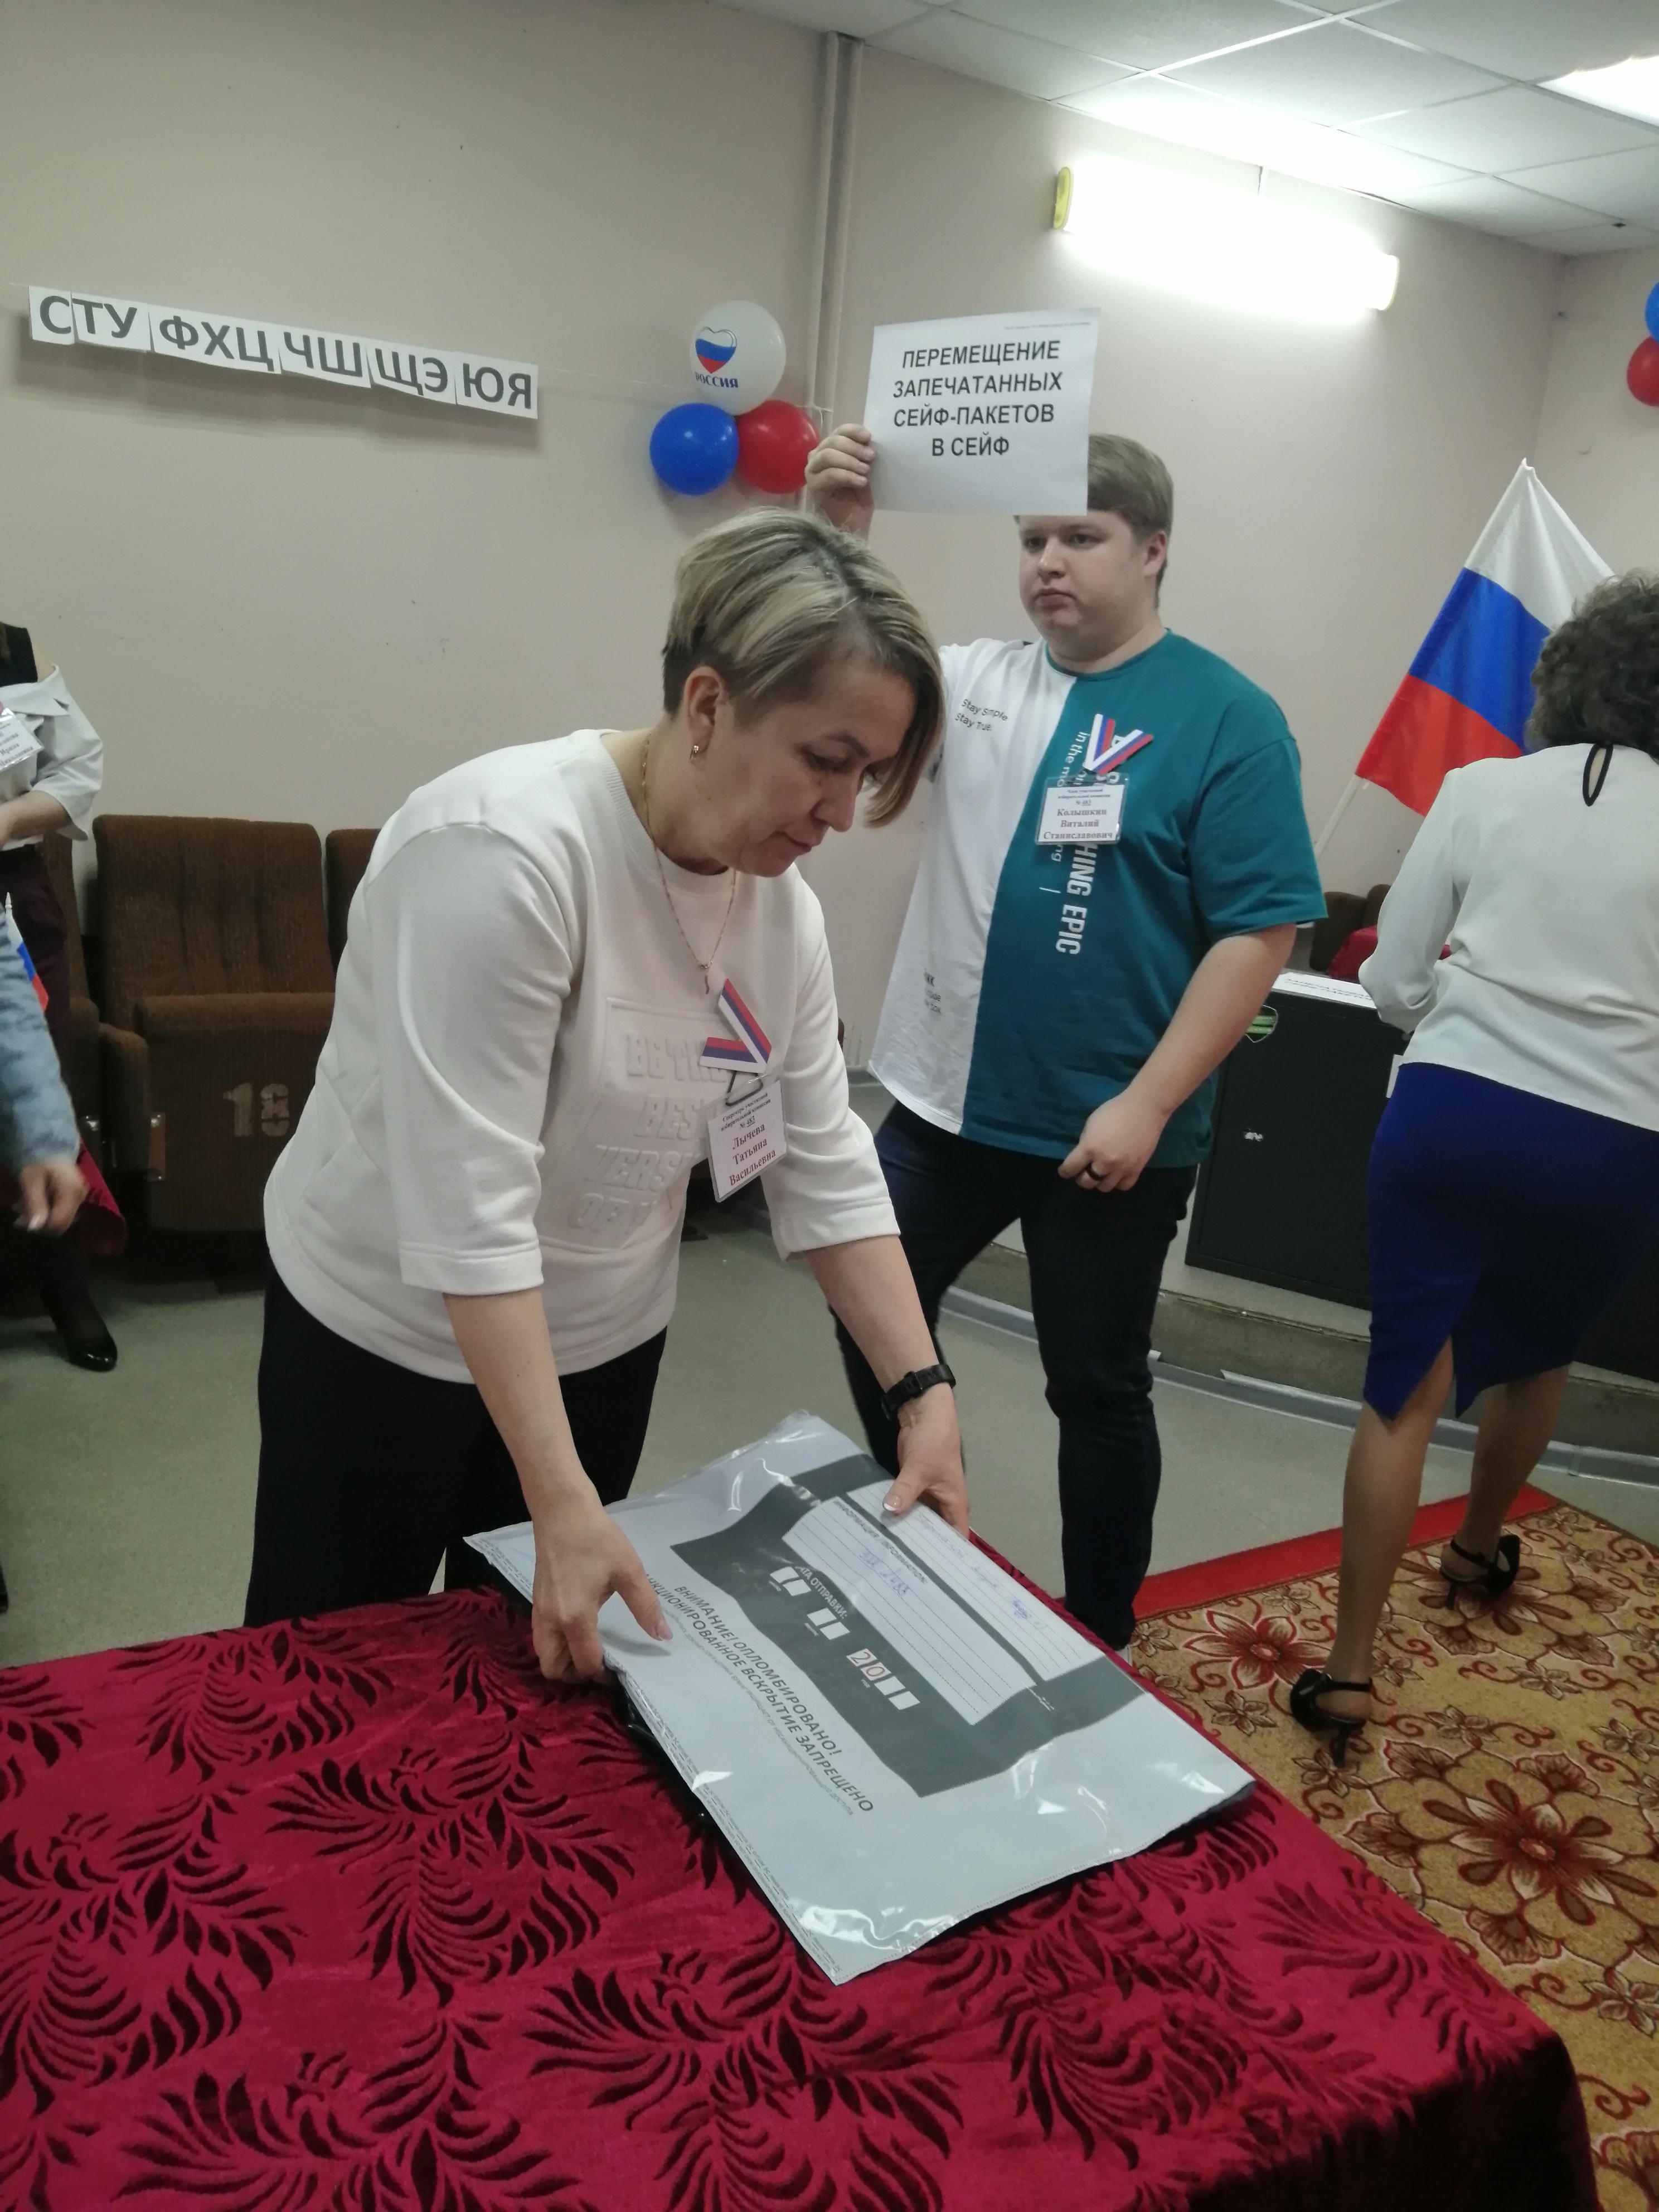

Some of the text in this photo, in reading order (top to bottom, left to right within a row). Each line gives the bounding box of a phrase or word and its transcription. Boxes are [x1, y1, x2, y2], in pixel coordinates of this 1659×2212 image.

[901, 339, 1061, 369] ПЕРЕМЕЩЕНИЕ
[462, 362, 532, 410] ЮЯ
[695, 372, 739, 389] РОССИЯ
[892, 371, 1063, 398] ЗАПЕЧАТАННЫХ
[893, 402, 1055, 427] СЕЙФ-ПАКЕТОВ
[932, 431, 1010, 457] В СЕЙФ
[1065, 744, 1083, 764] the
[1056, 808, 1107, 817] Колышкин
[1060, 819, 1100, 828] Виталий
[1044, 831, 1113, 840] Станиславович
[1055, 841, 1098, 955] HING EPIC
[732, 1123, 765, 1150] Лычева
[733, 1138, 768, 1165] Татьяна
[729, 1149, 777, 1186] Васильевна
[674, 1585, 736, 1645] ВНИМАНИЕ!
[733, 1641, 843, 1756] ОПЛОМБИРОВАНО!
[850, 1651, 885, 1677] 20
[646, 1574, 746, 1667] НКЦИОНИРОВАННОЕ
[741, 1665, 802, 1733] ВСКРЫТИЕ
[795, 1733, 874, 1812] ЗАПРЕЩЕНО
